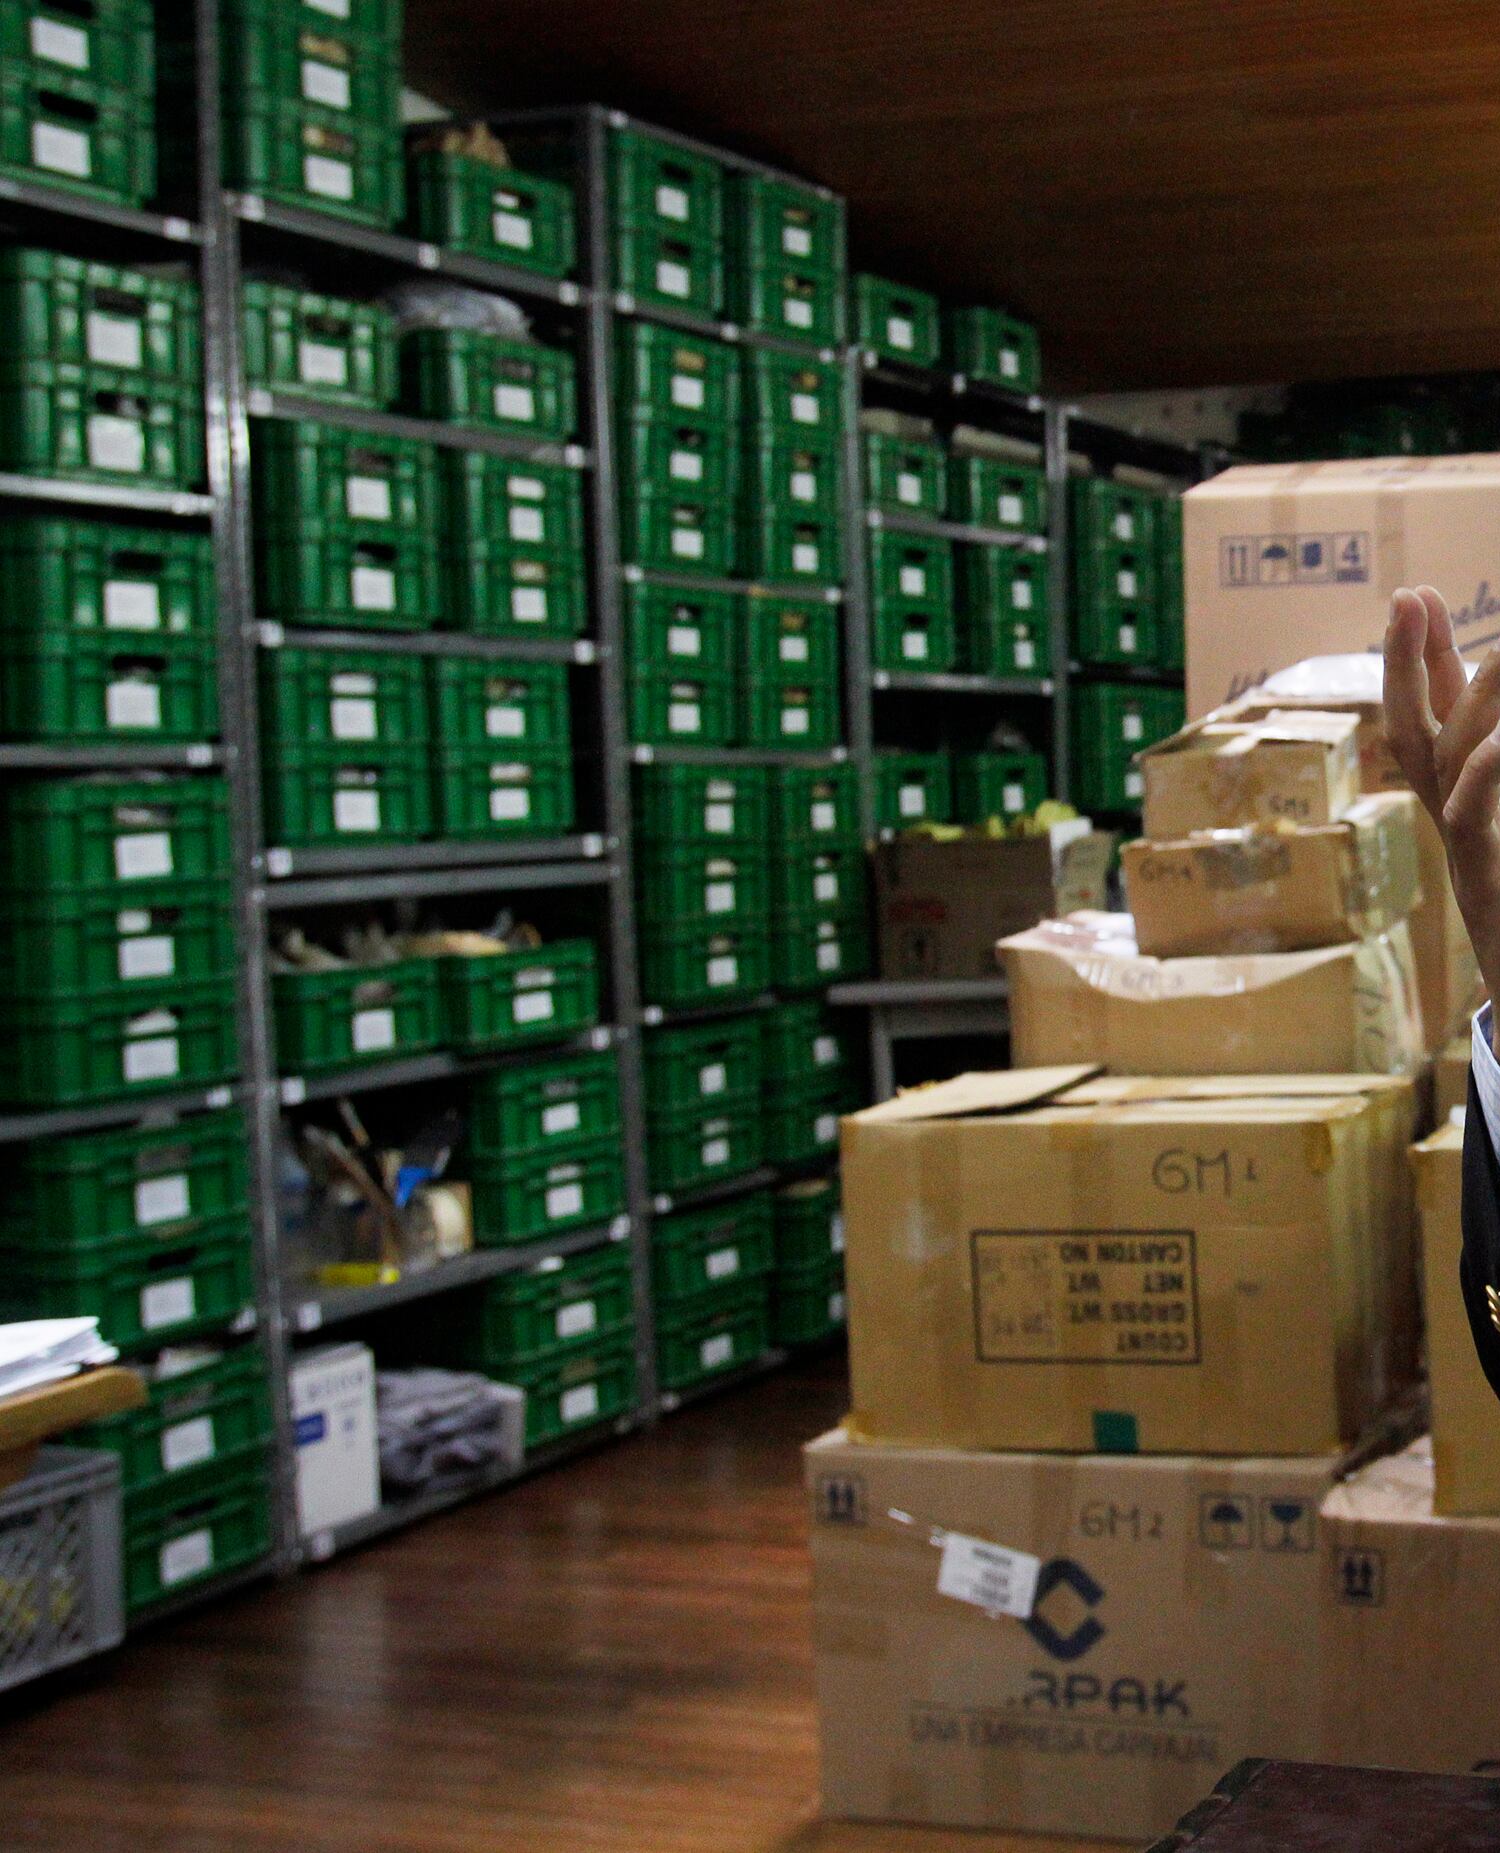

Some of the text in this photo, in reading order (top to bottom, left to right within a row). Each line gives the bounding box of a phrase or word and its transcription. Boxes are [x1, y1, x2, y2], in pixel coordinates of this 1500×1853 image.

[1097, 1242, 1182, 1264] CARTON
[1144, 1272, 1184, 1293] NET
[1117, 1331, 1188, 1353] COUNT
